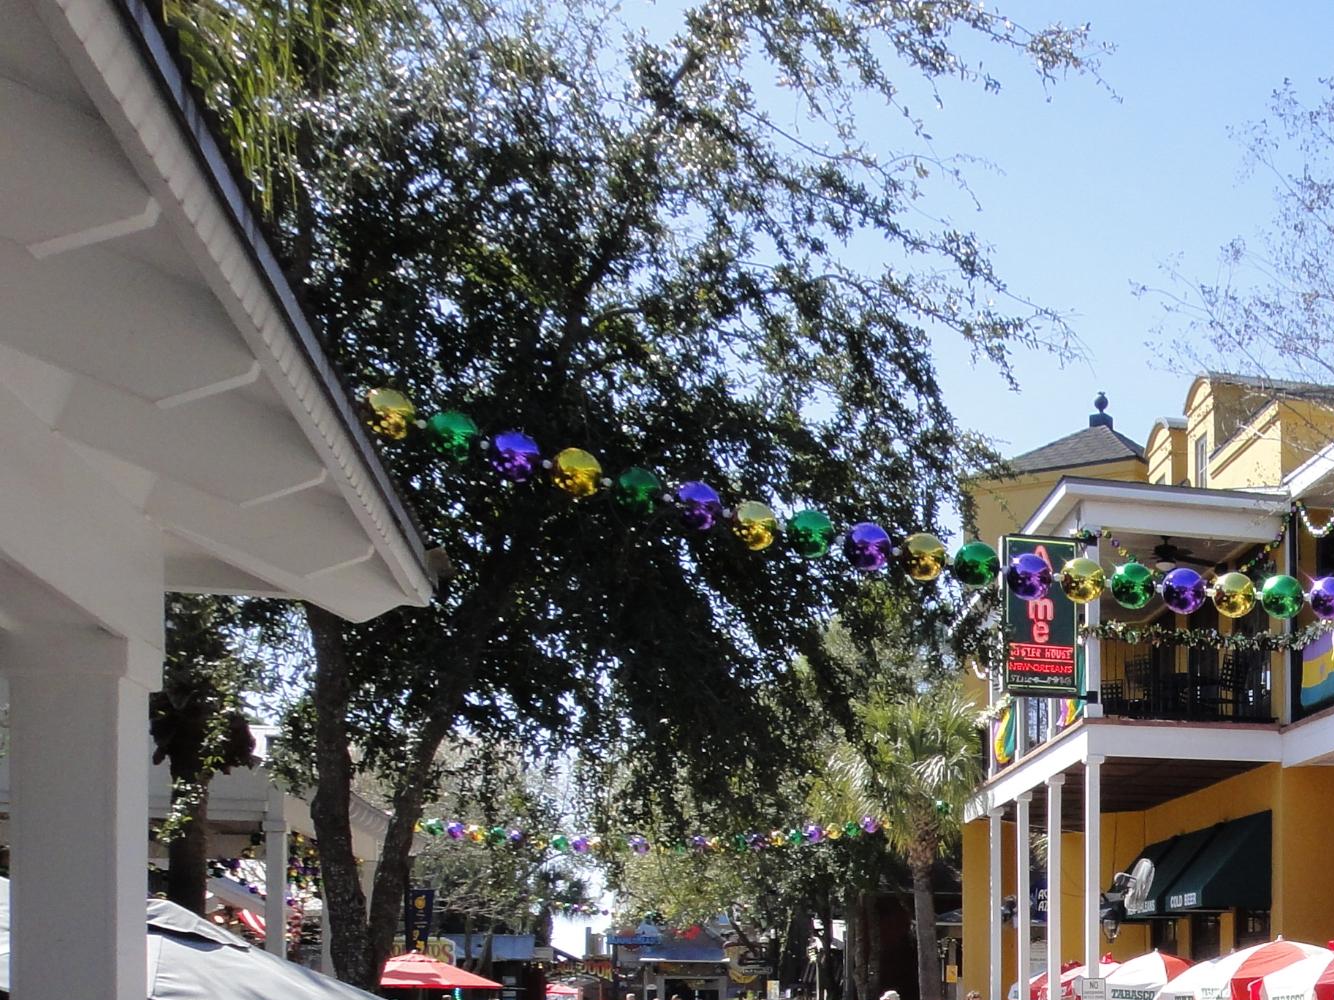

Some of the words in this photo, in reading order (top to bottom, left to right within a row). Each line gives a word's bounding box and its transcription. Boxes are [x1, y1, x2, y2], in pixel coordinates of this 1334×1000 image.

[1170, 895, 1182, 909] COLD
[1183, 892, 1197, 906] BEER
[1089, 981, 1099, 990] NO
[1111, 989, 1155, 1000] TABASCO
